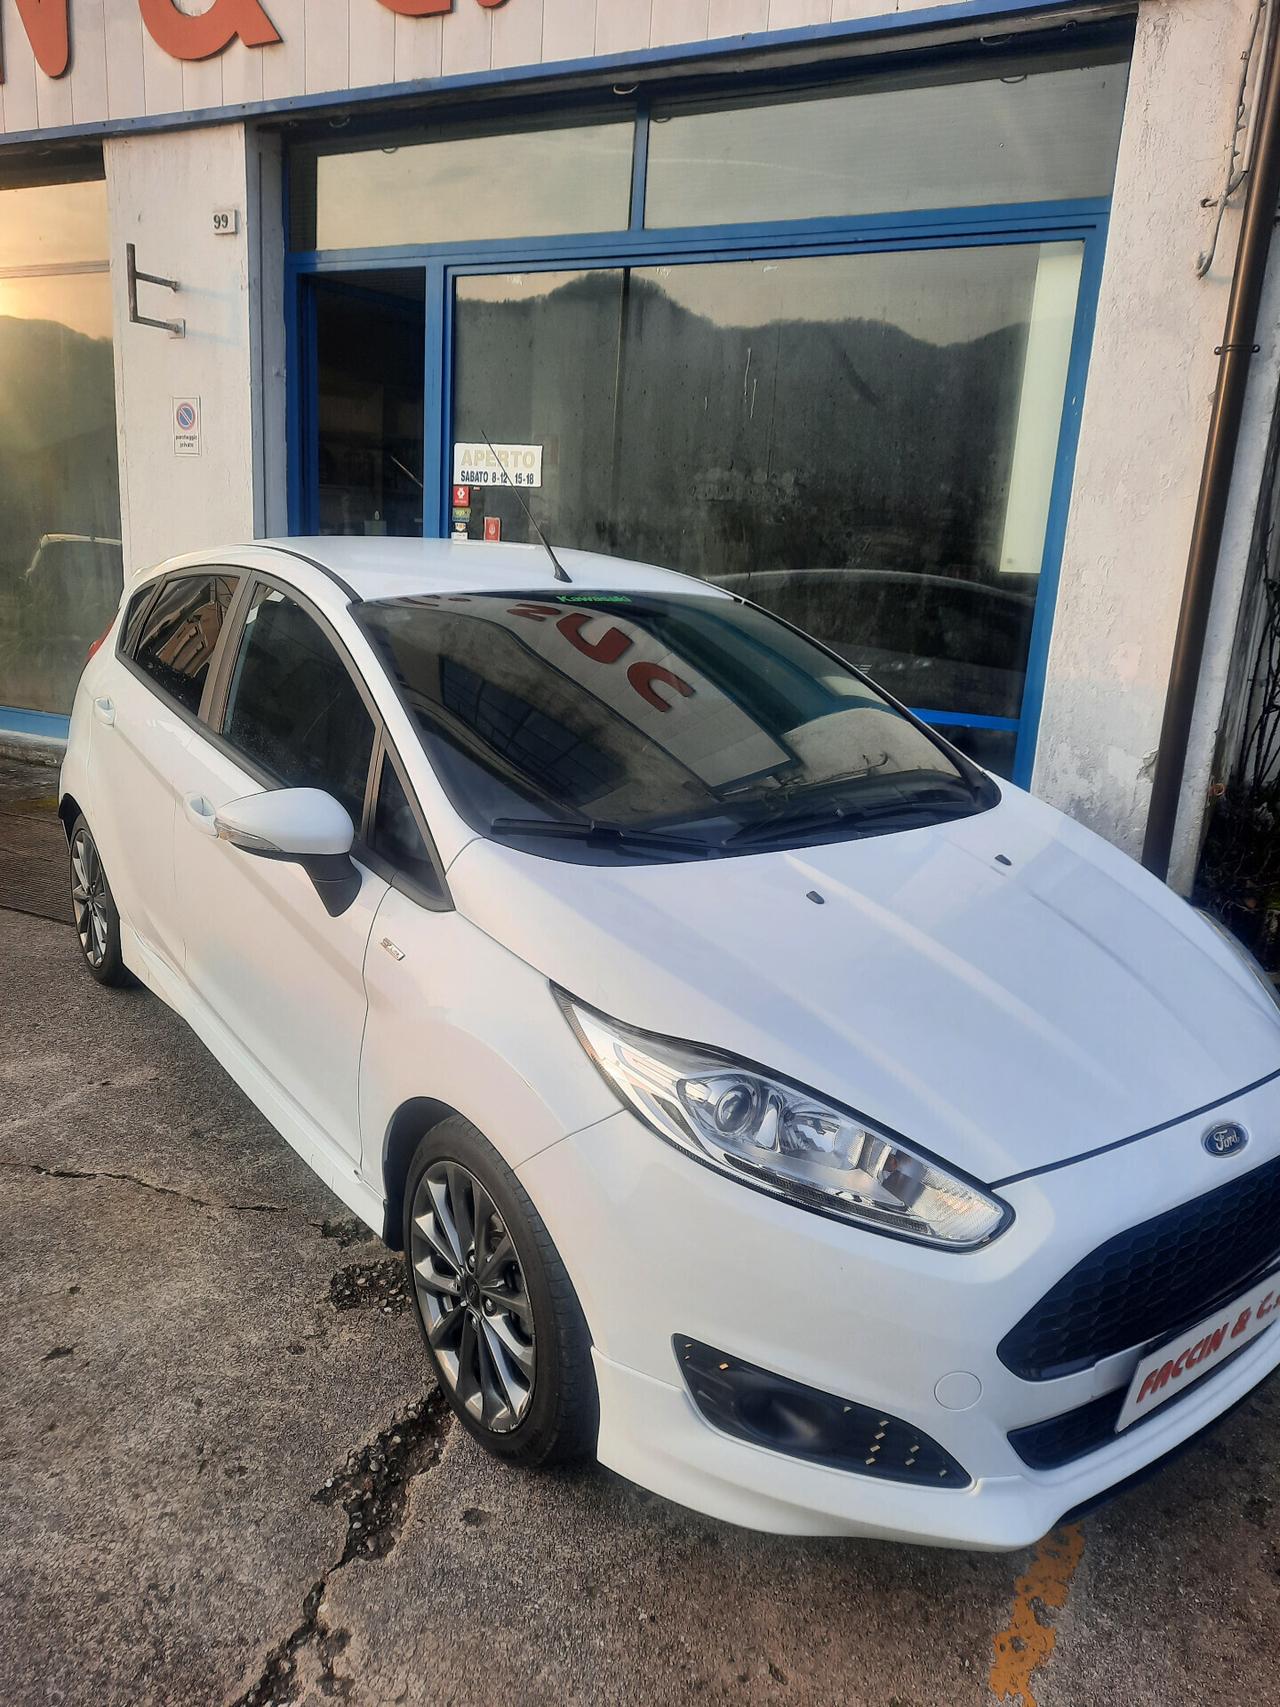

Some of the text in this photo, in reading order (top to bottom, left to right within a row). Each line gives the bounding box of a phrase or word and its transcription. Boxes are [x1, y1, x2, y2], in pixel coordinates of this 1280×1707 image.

[213, 214, 229, 230] 99
[461, 449, 536, 468] APERTO
[460, 470, 535, 485] SABATO 8-12 15-18
[1213, 1129, 1240, 1151] Ford
[1136, 1322, 1230, 1404] FACCIN
[1230, 1306, 1252, 1339] &
